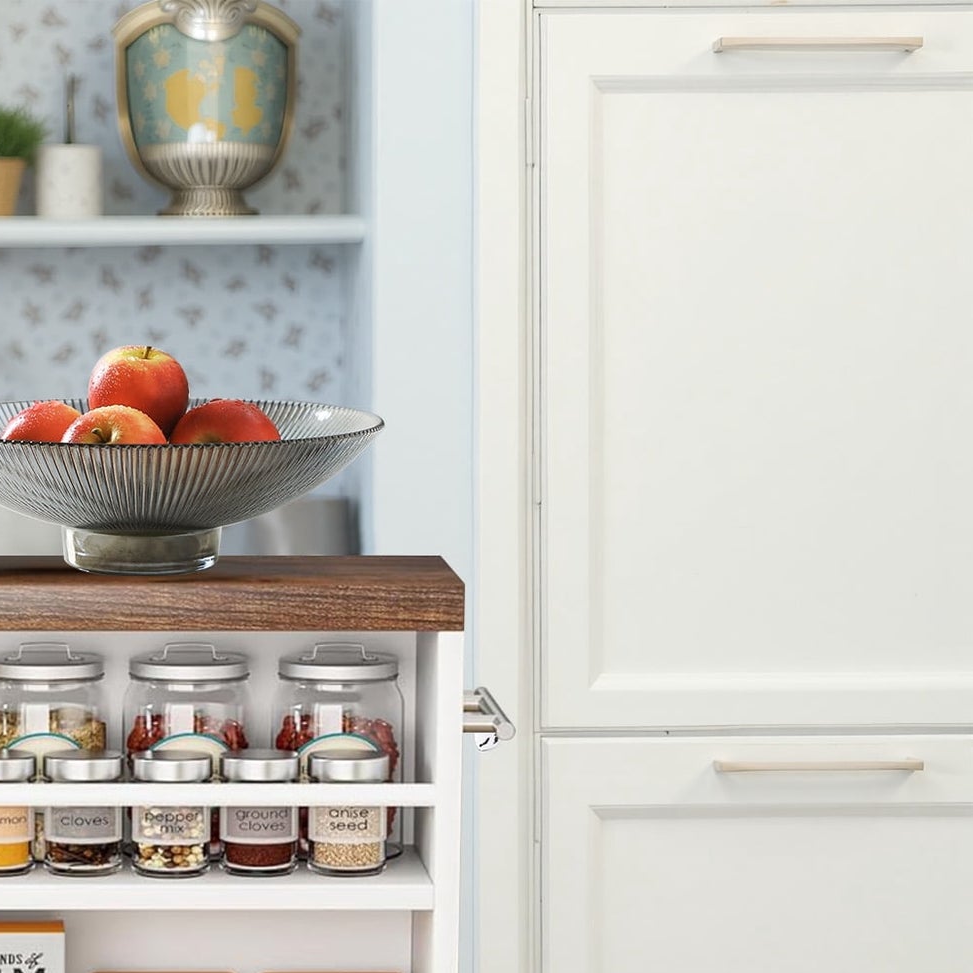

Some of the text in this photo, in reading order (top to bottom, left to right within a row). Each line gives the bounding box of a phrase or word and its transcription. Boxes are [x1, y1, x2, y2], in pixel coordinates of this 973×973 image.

[60, 812, 109, 826] cloves
[144, 811, 200, 823] pepper
[235, 807, 288, 822] ground
[328, 807, 369, 818] anise
[159, 822, 185, 834] mix
[238, 819, 286, 832] cloves
[329, 818, 368, 831] seed
[24, 952, 44, 969] of
